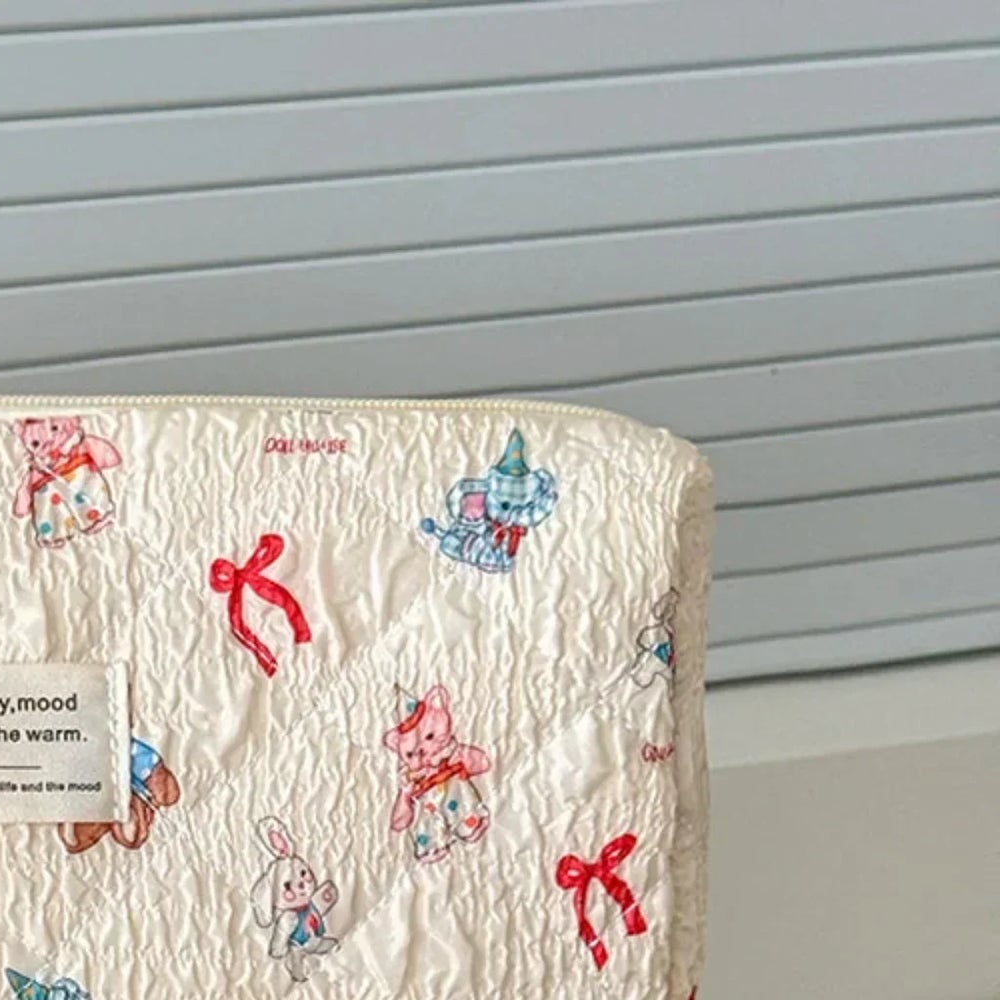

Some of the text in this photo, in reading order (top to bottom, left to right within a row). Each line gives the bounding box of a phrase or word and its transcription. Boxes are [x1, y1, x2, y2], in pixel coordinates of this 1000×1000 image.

[25, 727, 88, 743] warm.
[21, 781, 43, 793] and
[46, 781, 66, 793] the
[67, 781, 102, 793] mood
